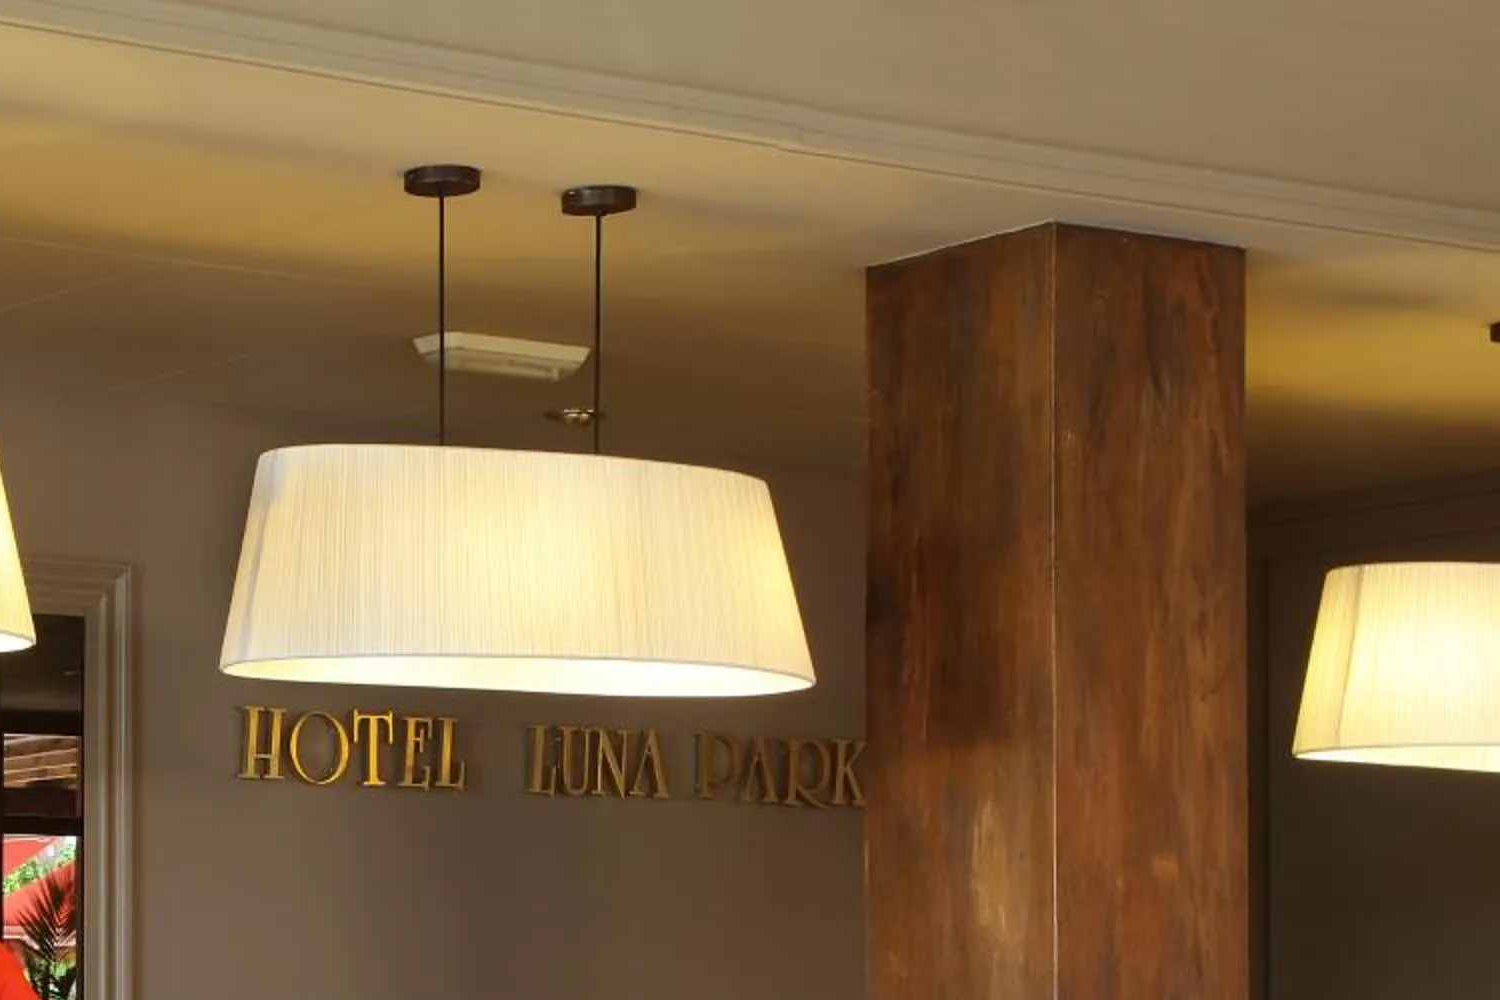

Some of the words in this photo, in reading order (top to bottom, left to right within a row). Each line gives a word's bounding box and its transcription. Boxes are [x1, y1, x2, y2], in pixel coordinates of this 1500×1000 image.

[237, 705, 466, 792] HOTEL
[527, 724, 672, 799] LUNA
[695, 731, 866, 809] PARK
